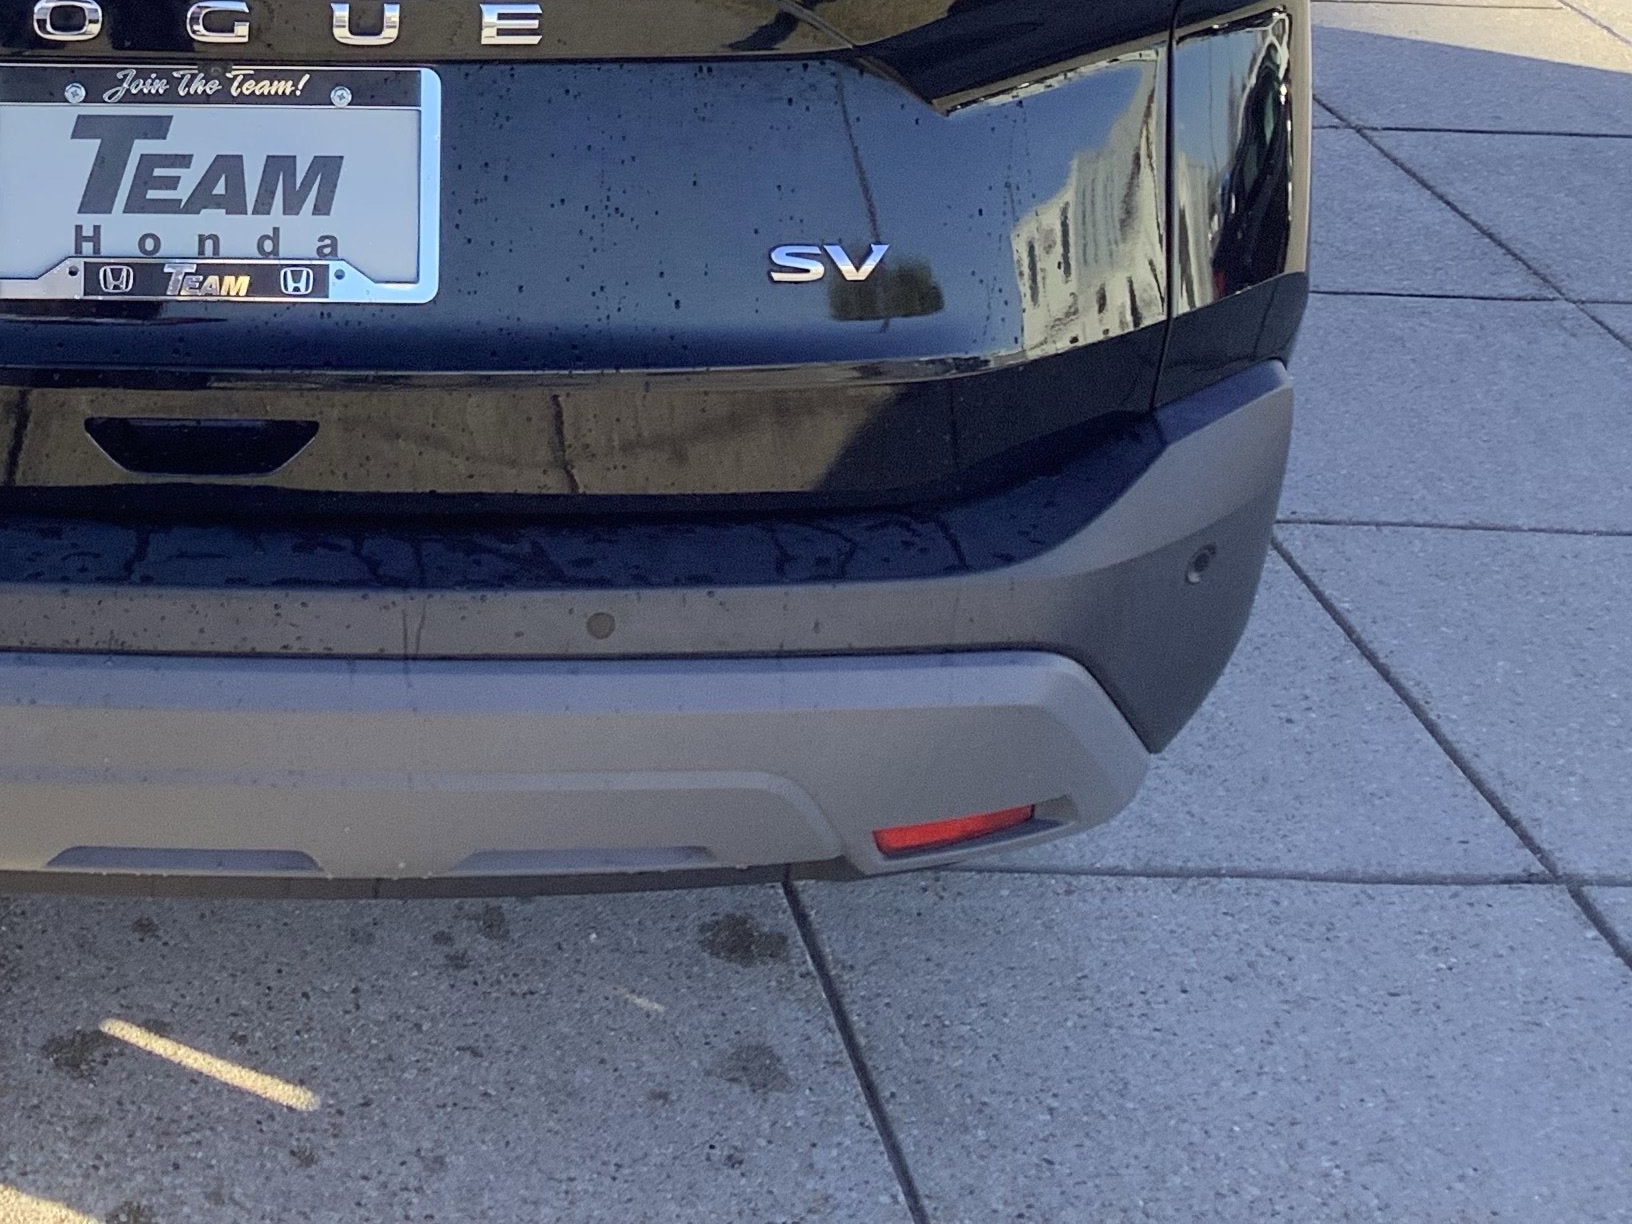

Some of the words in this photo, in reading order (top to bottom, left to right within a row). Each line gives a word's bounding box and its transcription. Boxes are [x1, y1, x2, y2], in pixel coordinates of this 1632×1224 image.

[103, 68, 170, 103] Join
[171, 68, 223, 97] The
[224, 68, 312, 97] Team!
[70, 114, 345, 217] TEAM
[73, 224, 340, 258] Honda
[163, 262, 251, 297] TEAM
[770, 244, 890, 282] SV
